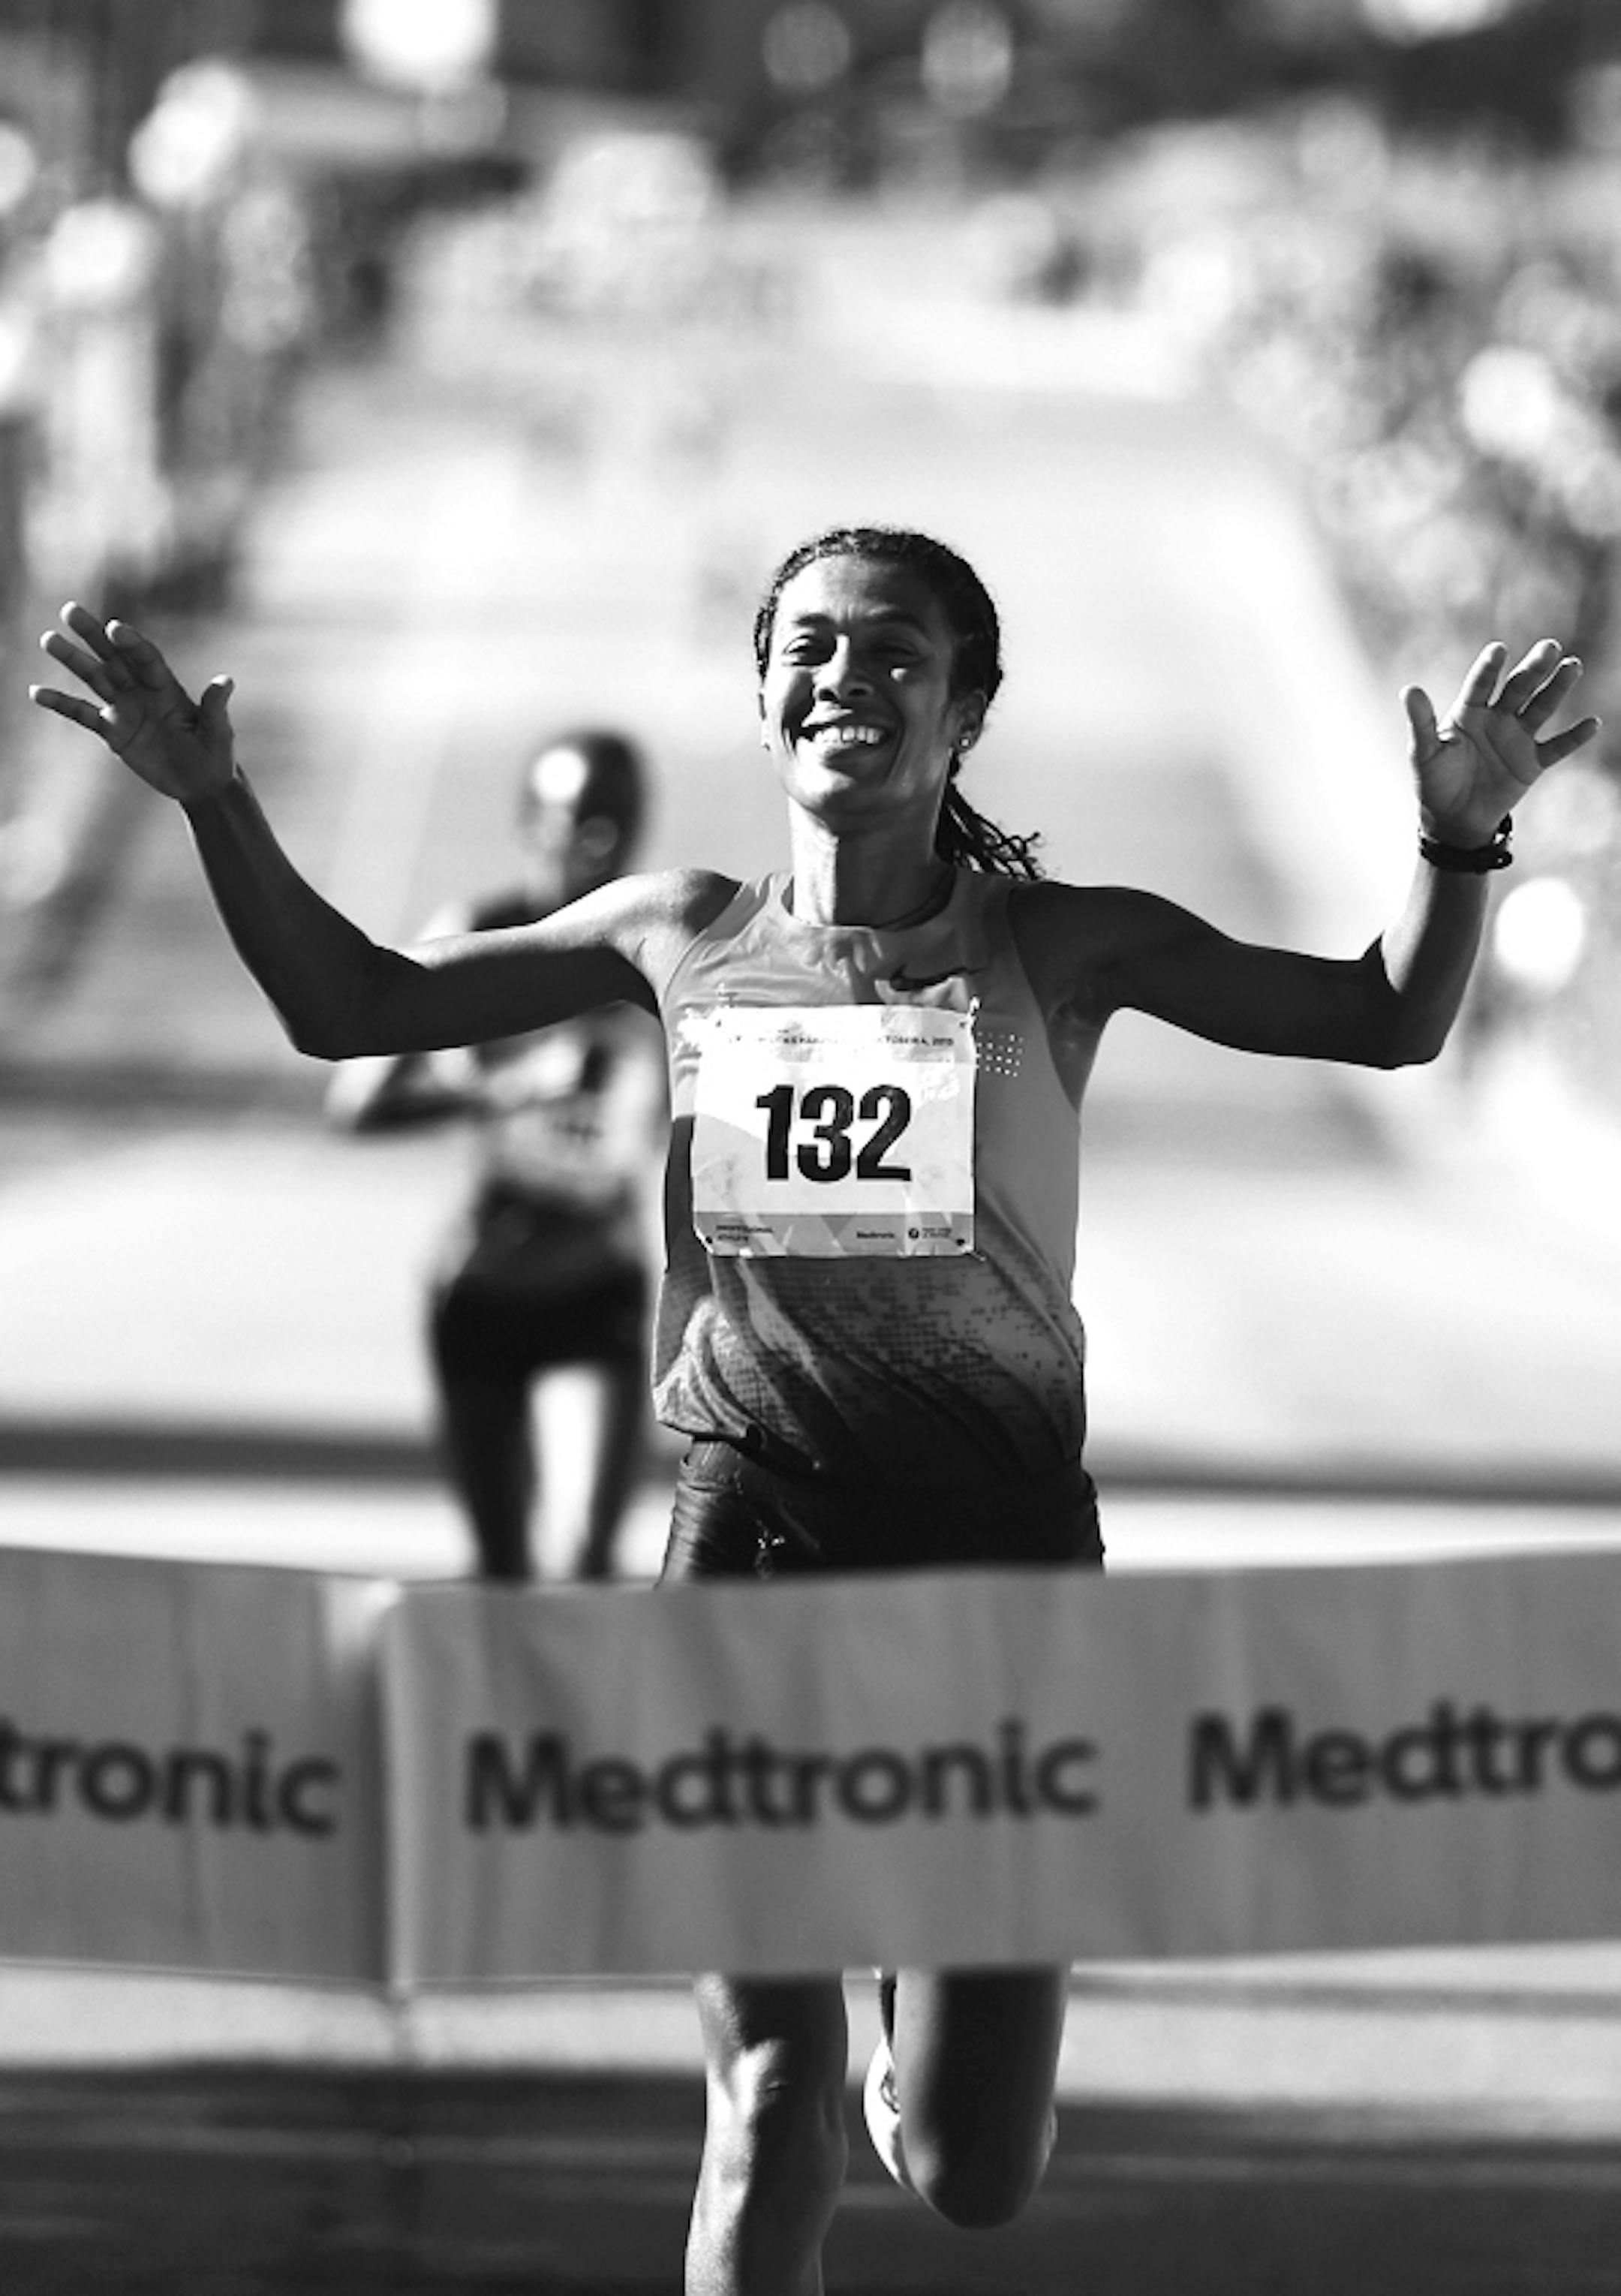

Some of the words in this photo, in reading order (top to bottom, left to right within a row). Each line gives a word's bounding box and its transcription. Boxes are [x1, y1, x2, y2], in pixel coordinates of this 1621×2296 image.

[756, 1085, 911, 1182] 132
[464, 1716, 1100, 1836] Medtronic
[1187, 1698, 1621, 1813] Medtro
